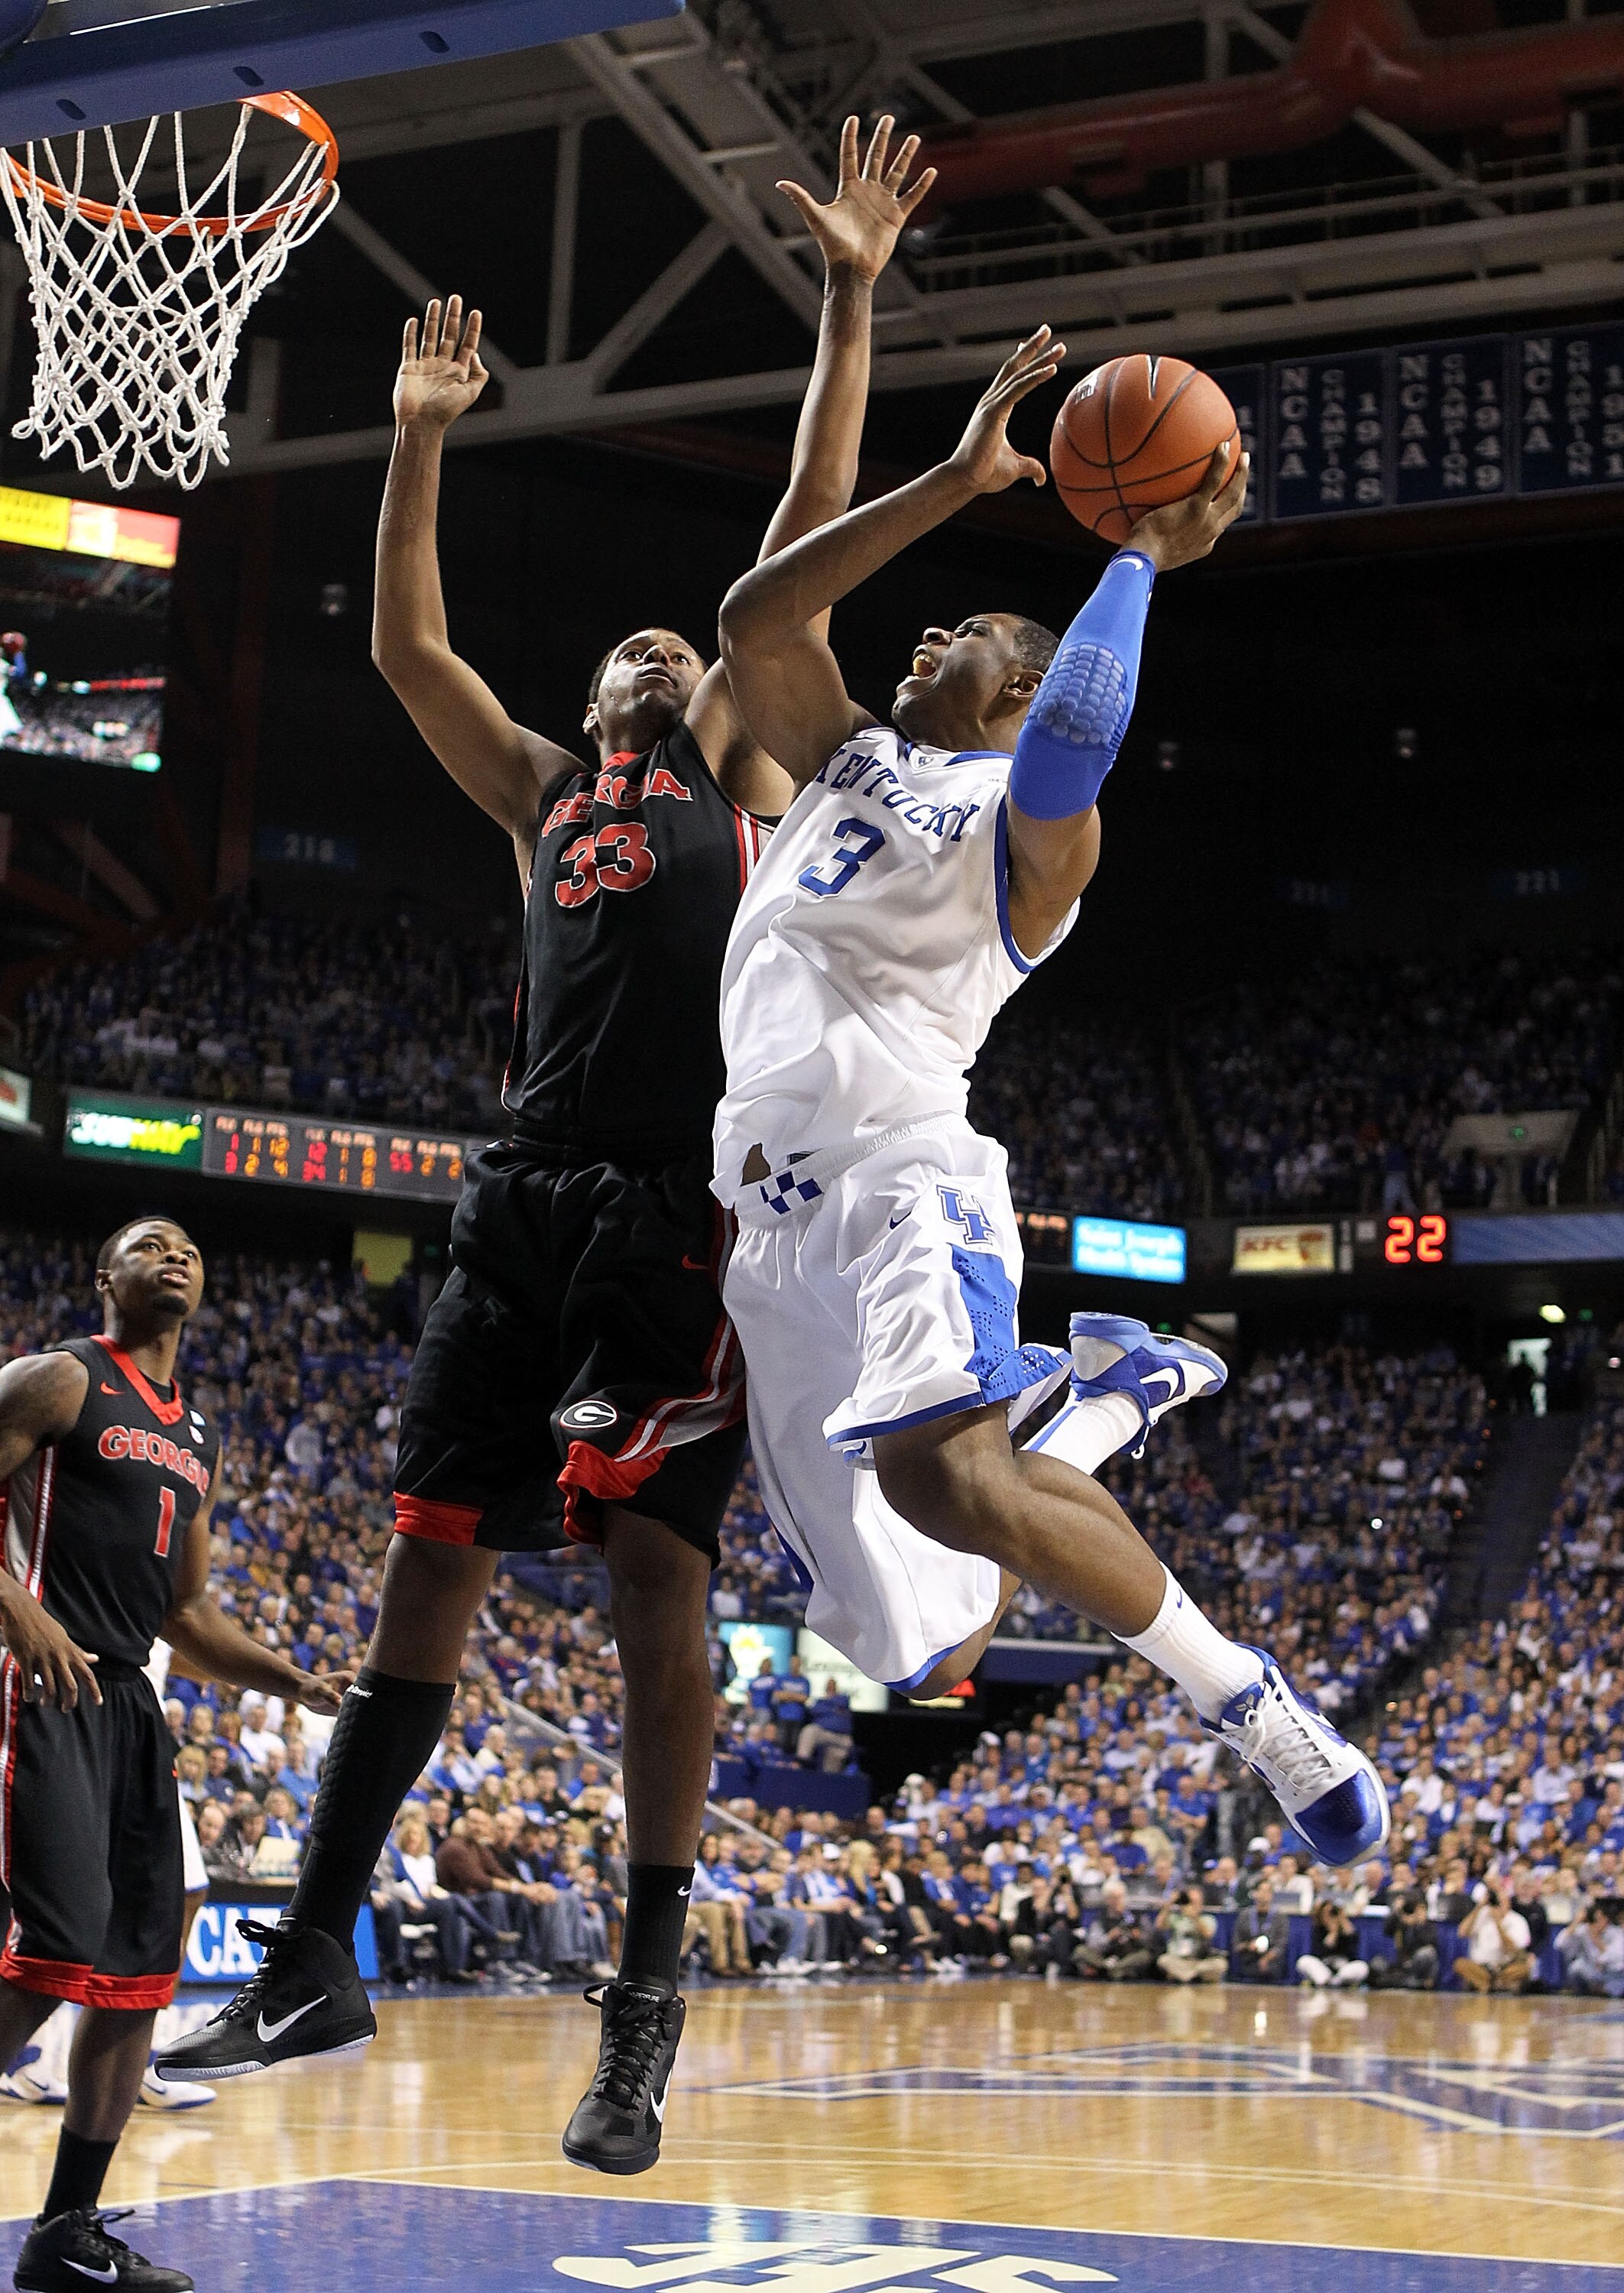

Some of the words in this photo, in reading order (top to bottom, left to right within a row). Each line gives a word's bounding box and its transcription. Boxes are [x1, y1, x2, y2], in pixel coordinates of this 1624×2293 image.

[1279, 367, 1308, 479] NCAA
[1399, 354, 1430, 469] NCAA
[1523, 339, 1553, 452] NCAA
[555, 821, 656, 909] 33
[798, 816, 886, 899] 3
[1241, 1235, 1286, 1253] KFC
[1385, 1215, 1447, 1263] 22
[154, 1485, 176, 1558] 1
